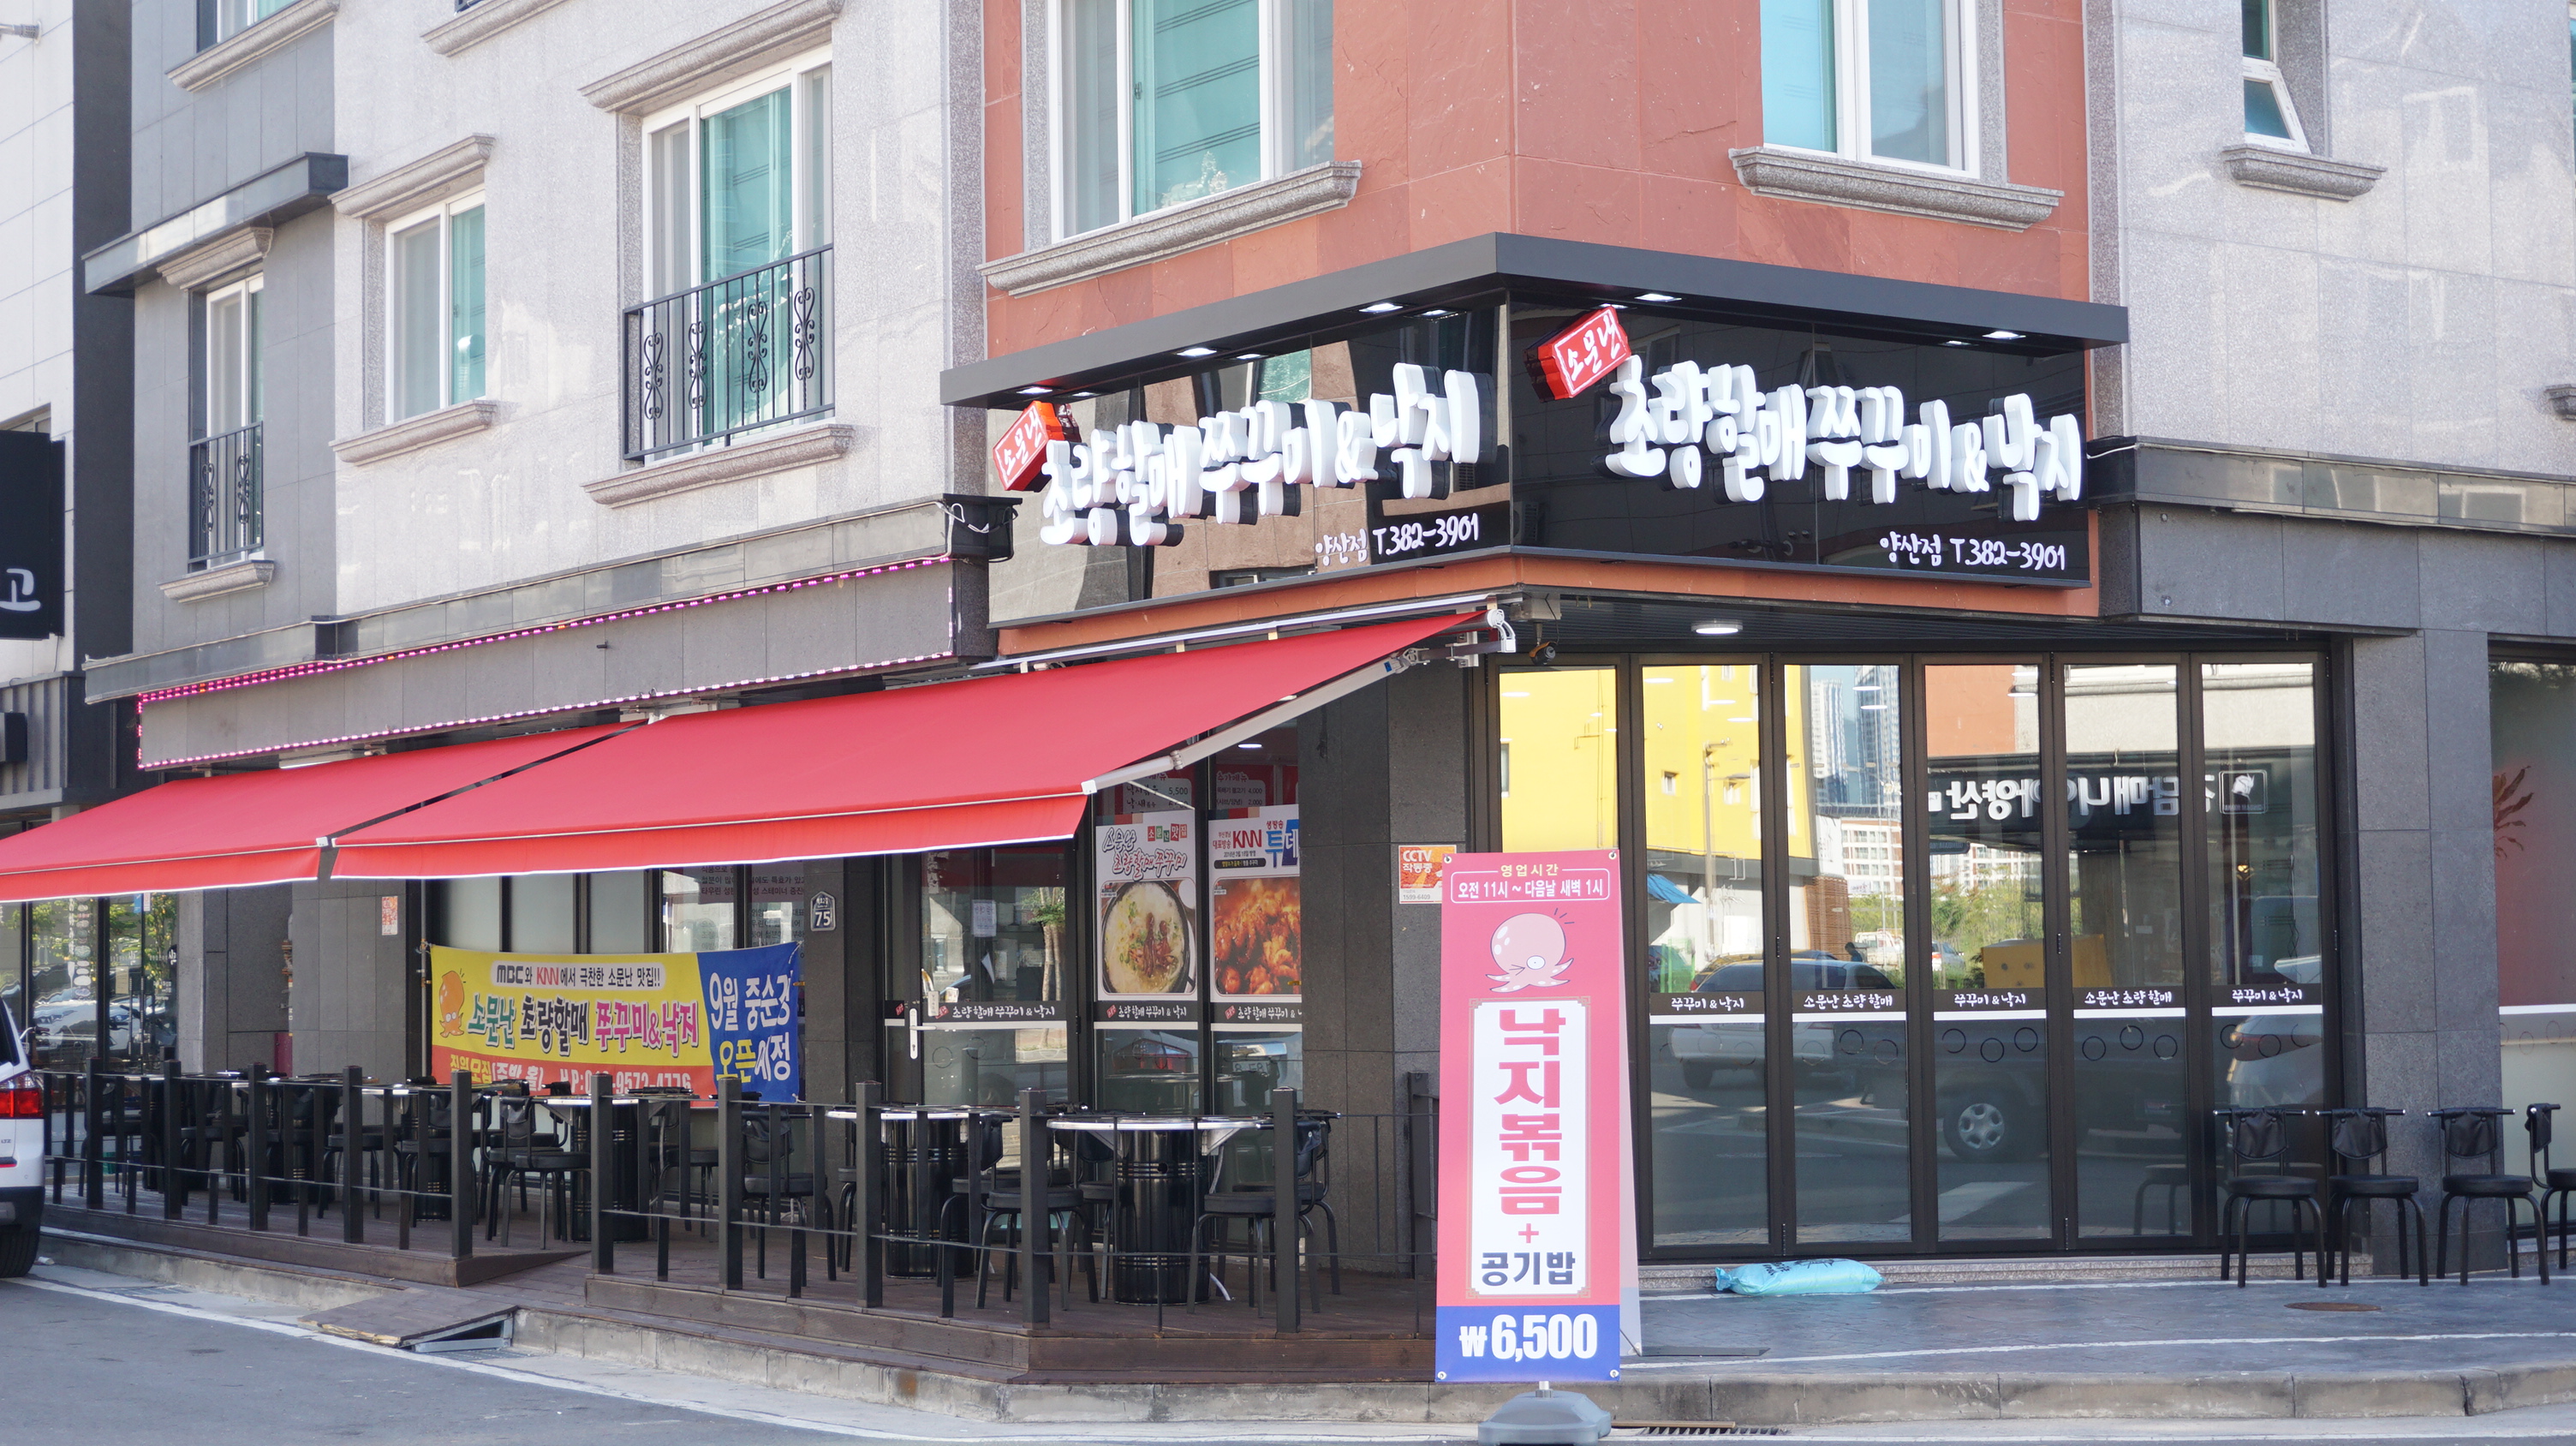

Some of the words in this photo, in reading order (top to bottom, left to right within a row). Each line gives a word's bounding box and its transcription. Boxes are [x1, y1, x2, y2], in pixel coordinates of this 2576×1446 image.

[1568, 314, 1621, 382] 소문난
[1315, 528, 1368, 566] 양산점
[1373, 512, 1479, 556] T.382-3901
[1880, 530, 1941, 566] 양산점
[1949, 537, 2066, 571] T.382-3901
[1168, 786, 1189, 796] 5,500
[1232, 829, 1262, 849] KNN
[1403, 850, 1432, 862] CCTV
[1403, 863, 1433, 874] 작동중
[1500, 863, 1559, 877] 영업시간
[701, 887, 722, 895] 타우린
[1458, 881, 1479, 899] 오전
[1483, 881, 1508, 898] 11시
[1524, 880, 1556, 898] 다음날
[1559, 879, 1582, 897] 새벽
[1585, 878, 1603, 896] 1시
[814, 911, 832, 926] 75
[580, 967, 604, 988] 극찬한
[608, 967, 633, 988] 소문난
[636, 966, 660, 988] 맛집!!
[709, 971, 740, 1031] 9월
[1804, 995, 1840, 1009] 소문난
[1954, 994, 1989, 1007] 쭈꾸미
[2001, 991, 2026, 1007] 낙지
[2084, 991, 2120, 1006] 소문난
[2232, 989, 2267, 1003] 쭈꾸미
[2278, 987, 2303, 1003] 낙지
[1671, 997, 1707, 1011] 쭈꾸미
[1719, 995, 1744, 1012] 낙지
[1035, 1005, 1055, 1019] 낙지
[1172, 1006, 1187, 1019] 낙지
[468, 992, 516, 1049] 소문난
[520, 993, 590, 1056] 초량할매
[1494, 1007, 1566, 1216] 낙지볶음
[1481, 1251, 1576, 1287] 공기밥
